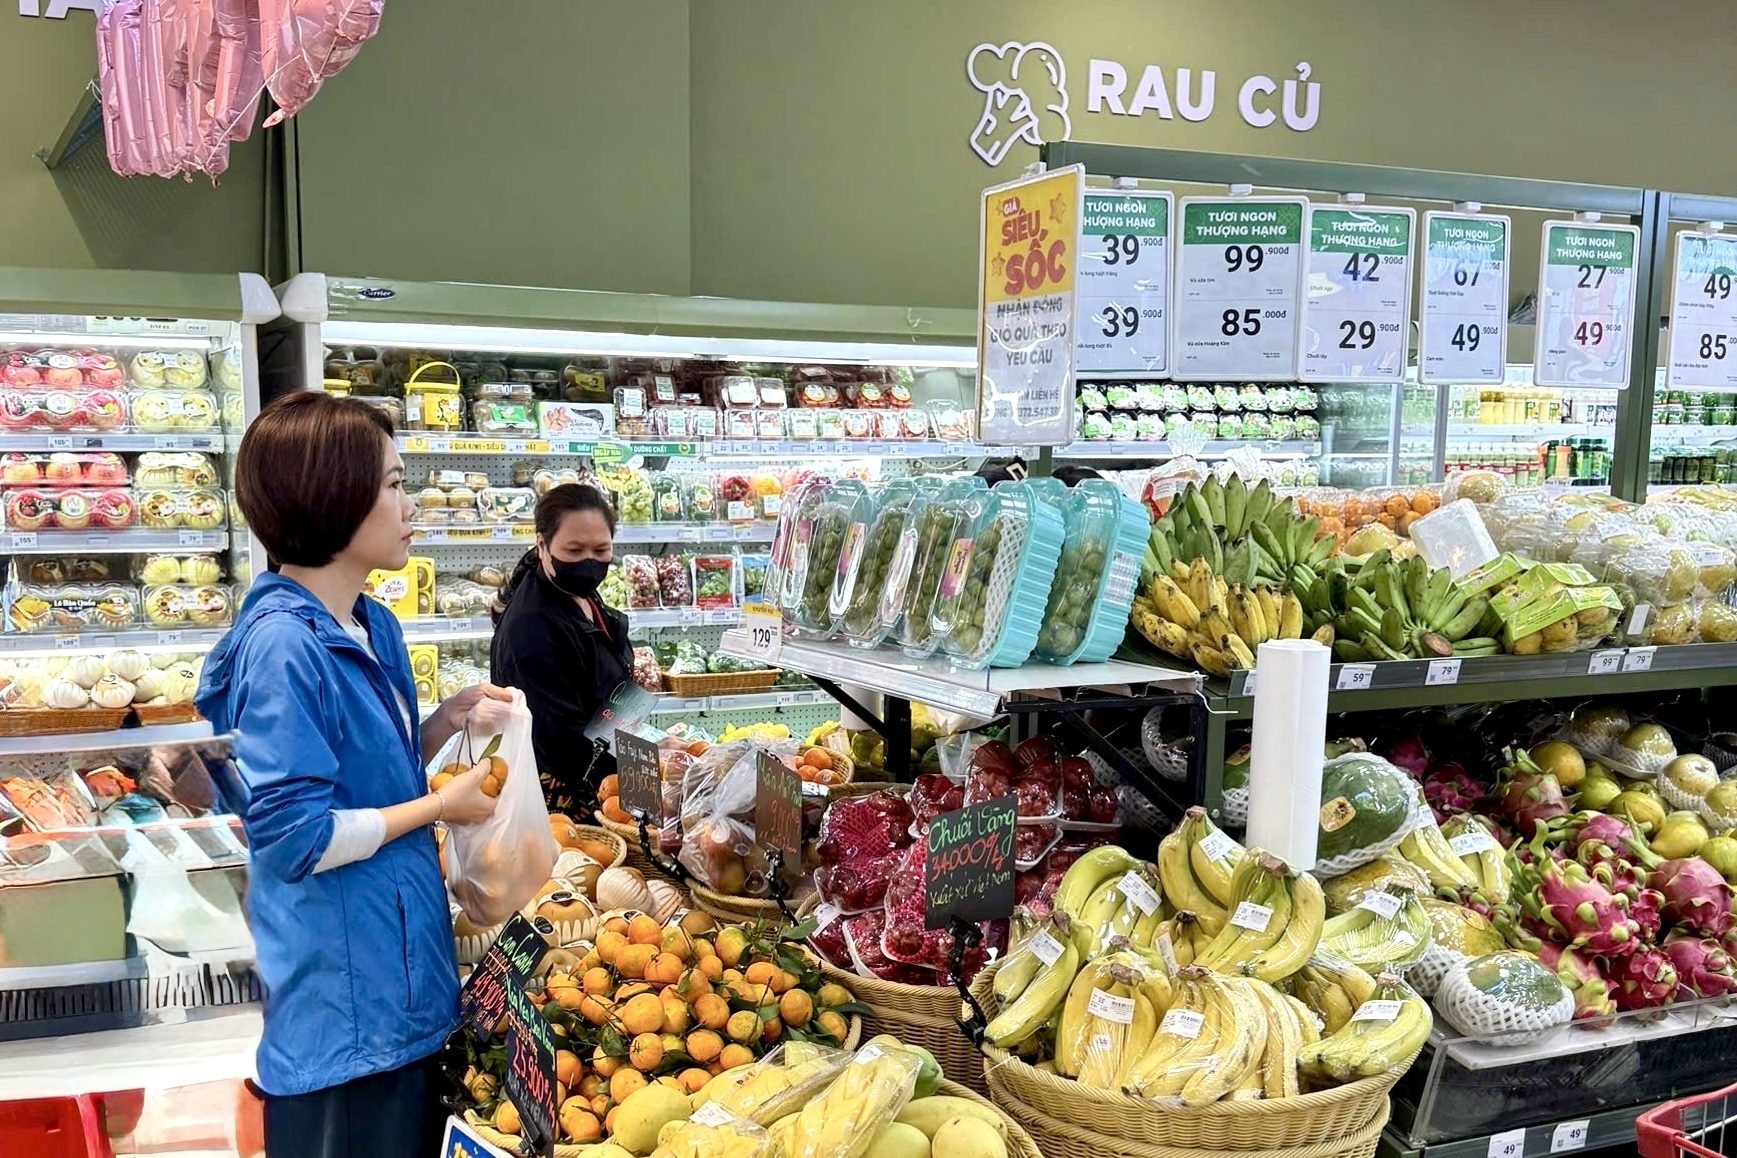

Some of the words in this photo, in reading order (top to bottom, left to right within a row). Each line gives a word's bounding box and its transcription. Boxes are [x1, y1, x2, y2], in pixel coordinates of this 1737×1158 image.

[1087, 59, 1216, 122] RAU
[1238, 61, 1321, 132] CỦ
[1086, 201, 1113, 213] TƯƠI
[1115, 202, 1147, 214] NGON
[1208, 211, 1237, 222] TƯƠI
[1240, 211, 1277, 222] NGON
[1001, 209, 1041, 247] SIÊU
[1084, 214, 1124, 229] HƯỢNG
[1126, 217, 1156, 230] HẠNG
[1196, 225, 1249, 239] THƯỢNG
[1252, 225, 1288, 238] HẠNG
[1331, 221, 1357, 231] TƯƠI
[1358, 223, 1389, 234] NGON
[1444, 228, 1464, 238] TƯƠI
[1465, 229, 1489, 240] NGON
[1565, 236, 1587, 246] TƯƠI
[1588, 238, 1616, 248] NGON
[1102, 234, 1140, 266] 39
[1224, 244, 1264, 273] 99
[1265, 246, 1290, 255] .900đ
[1556, 247, 1595, 260] THƯỢNG
[1597, 250, 1623, 262] HẠNG
[1003, 229, 1067, 296] SỐC
[1342, 252, 1380, 282] 42
[1577, 264, 1607, 289] 27
[1703, 273, 1731, 300] 49
[1102, 306, 1140, 338] 39
[1221, 308, 1261, 336] 85
[1262, 310, 1287, 319] .000đ
[1338, 319, 1376, 350] 29
[1451, 324, 1480, 352] 49
[1573, 321, 1603, 346] 49
[1699, 333, 1728, 360] 85
[752, 628, 771, 648] 129
[1441, 666, 1453, 675] 79
[1602, 657, 1613, 667] 99
[1636, 655, 1646, 664] 79
[1353, 673, 1365, 683] 59
[928, 808, 973, 853] Chuối
[1569, 1128, 1581, 1139] 49
[1503, 1143, 1516, 1155] 49
